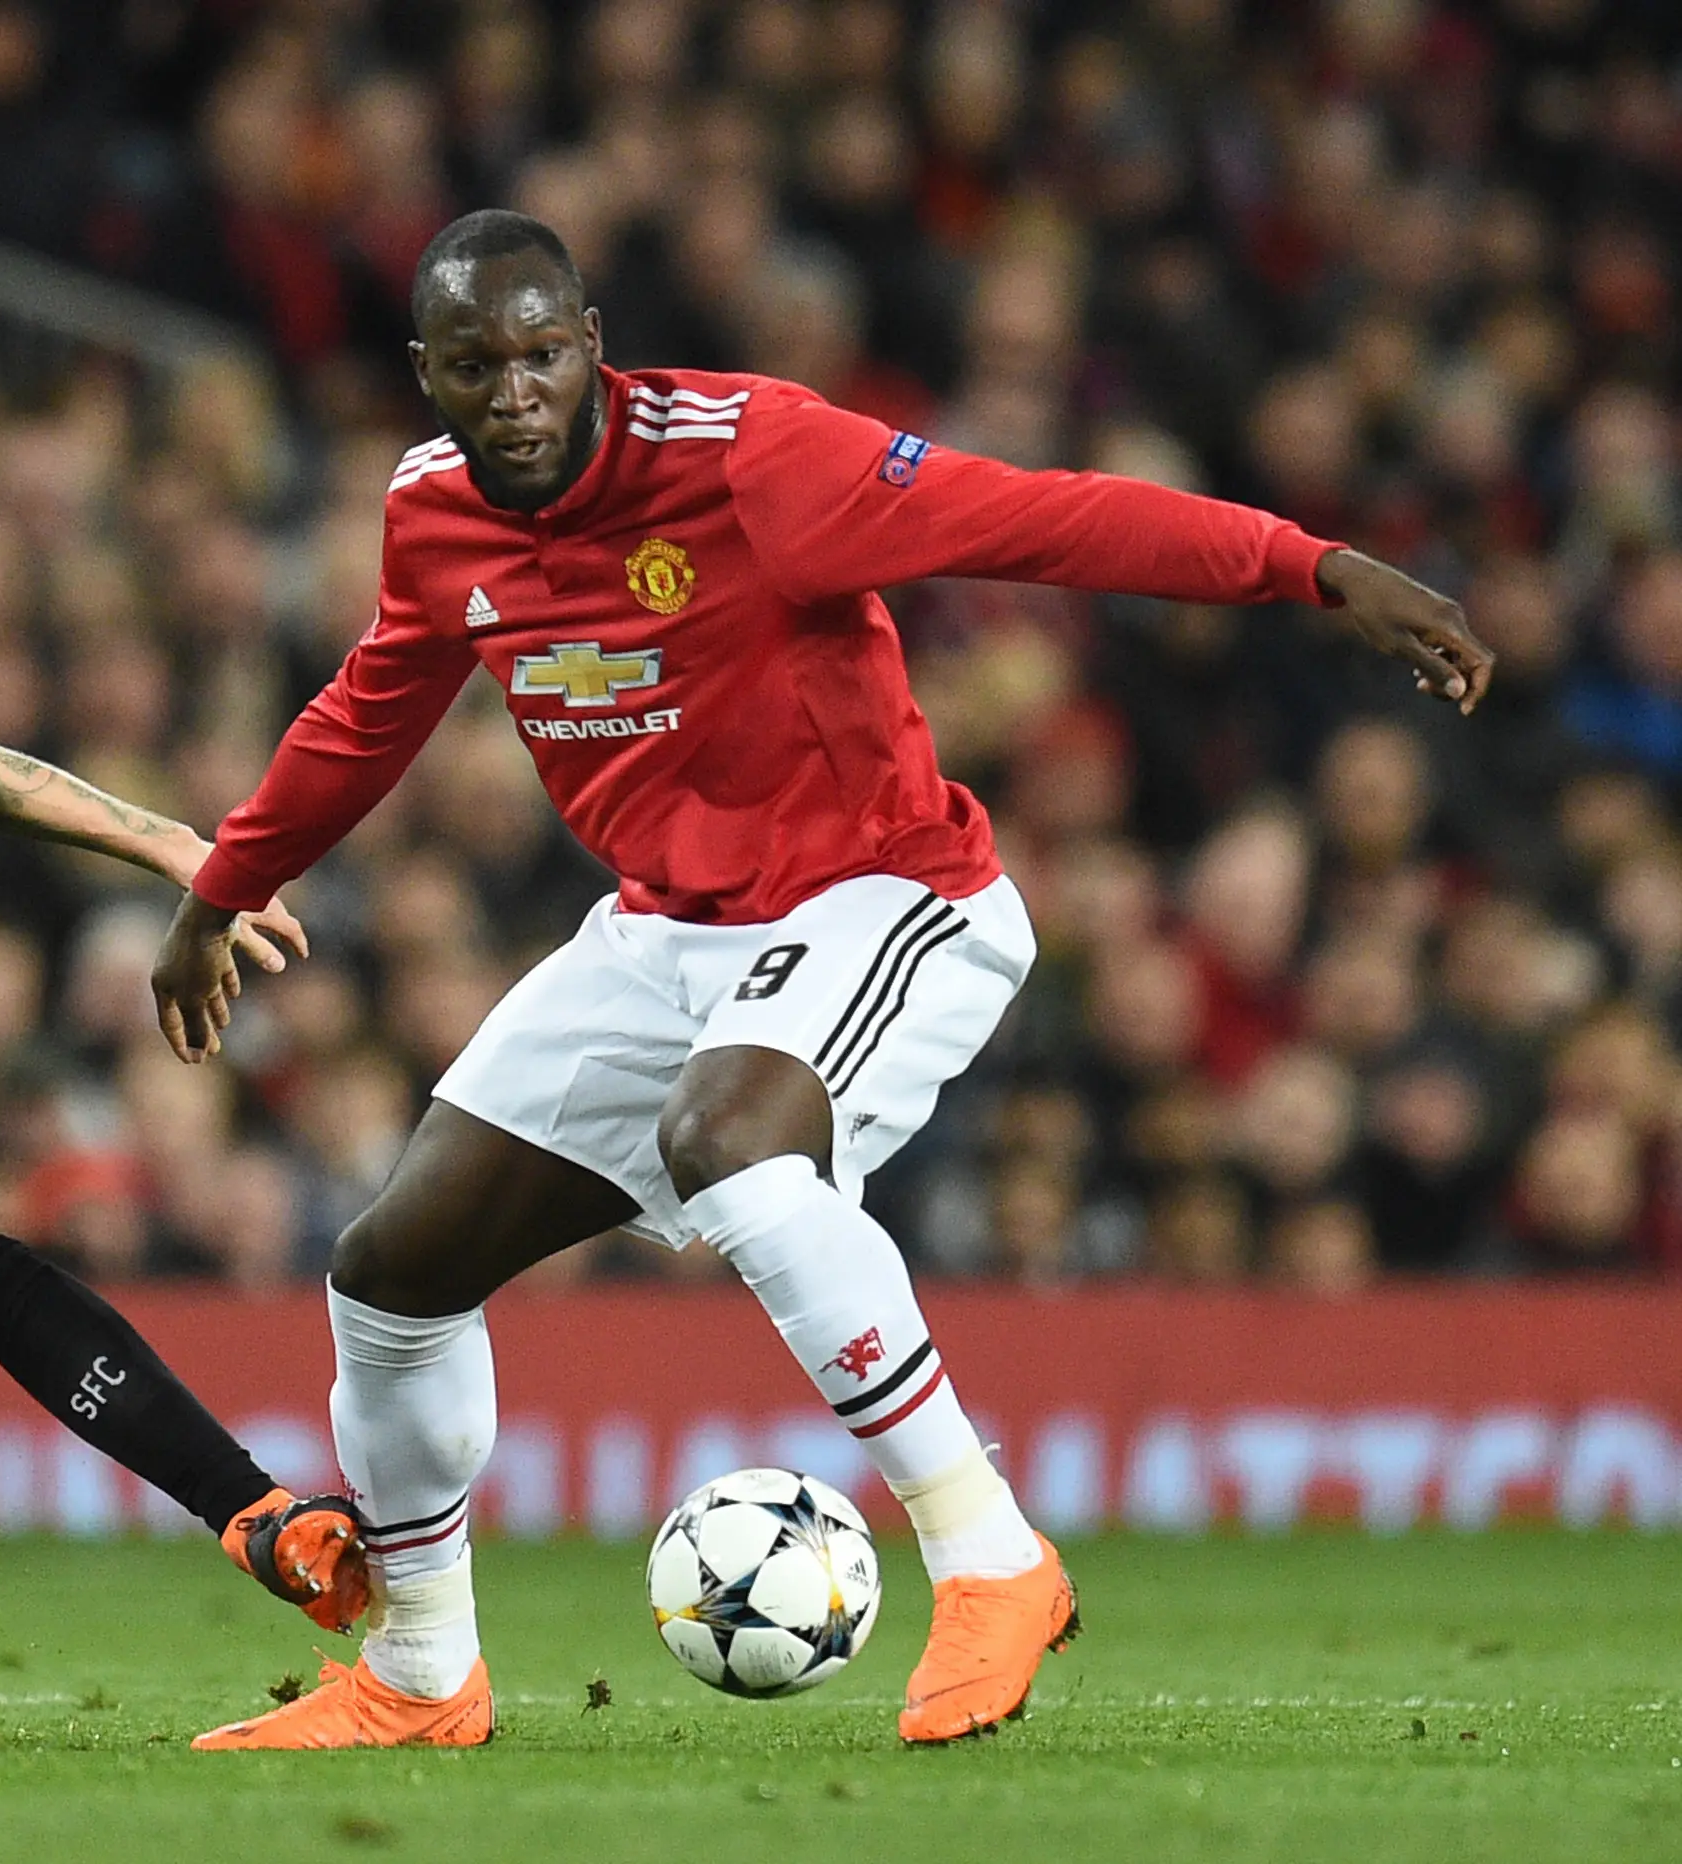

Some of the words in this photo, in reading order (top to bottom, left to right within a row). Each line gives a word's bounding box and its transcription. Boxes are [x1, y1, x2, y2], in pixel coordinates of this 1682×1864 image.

[521, 708, 682, 740] CHEVROLET
[733, 942, 811, 1002] 9
[70, 1355, 126, 1420] SFC
